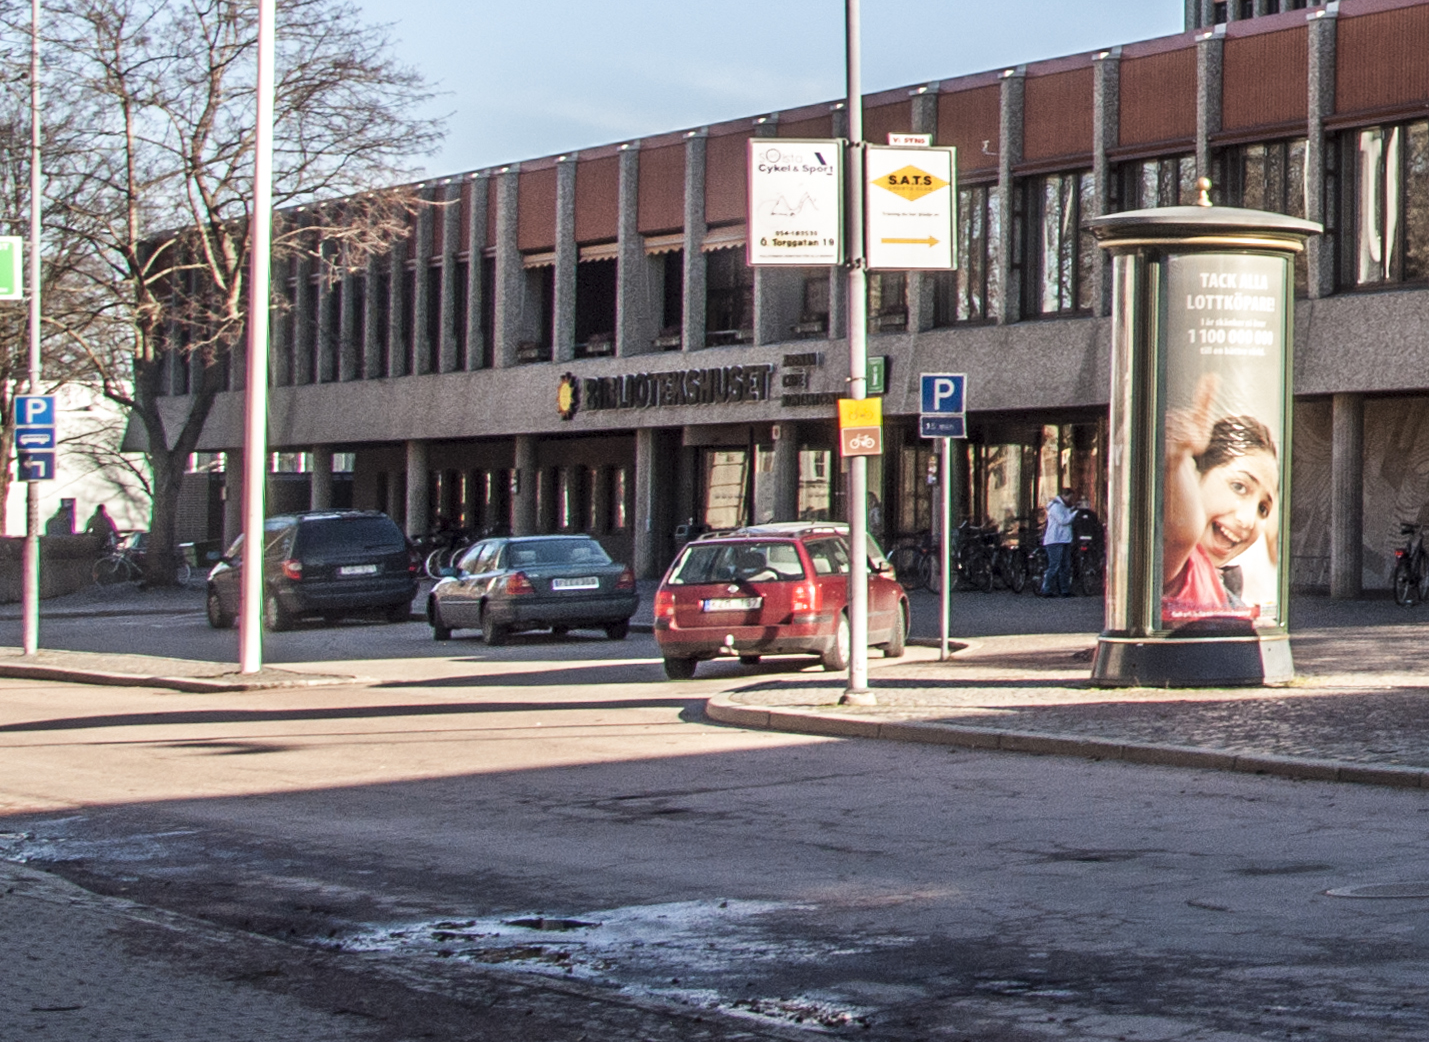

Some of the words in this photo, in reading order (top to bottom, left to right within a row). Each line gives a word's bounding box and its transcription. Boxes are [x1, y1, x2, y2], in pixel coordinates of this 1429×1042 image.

[758, 164, 791, 174] Cykel
[802, 164, 833, 176] Sport
[772, 238, 819, 248] Torggatan
[823, 238, 834, 246] 19
[1200, 273, 1236, 288] TACK
[1239, 273, 1268, 290] ALLA
[1186, 292, 1275, 313] LOTTKÖPARE!
[1188, 329, 1196, 344] 1
[1199, 329, 1226, 344] 100
[1228, 329, 1253, 345] 000
[1254, 330, 1273, 346] 000
[583, 363, 773, 410] BIBLIOTEKSHUSET
[934, 378, 955, 410] P
[26, 399, 47, 424] P
